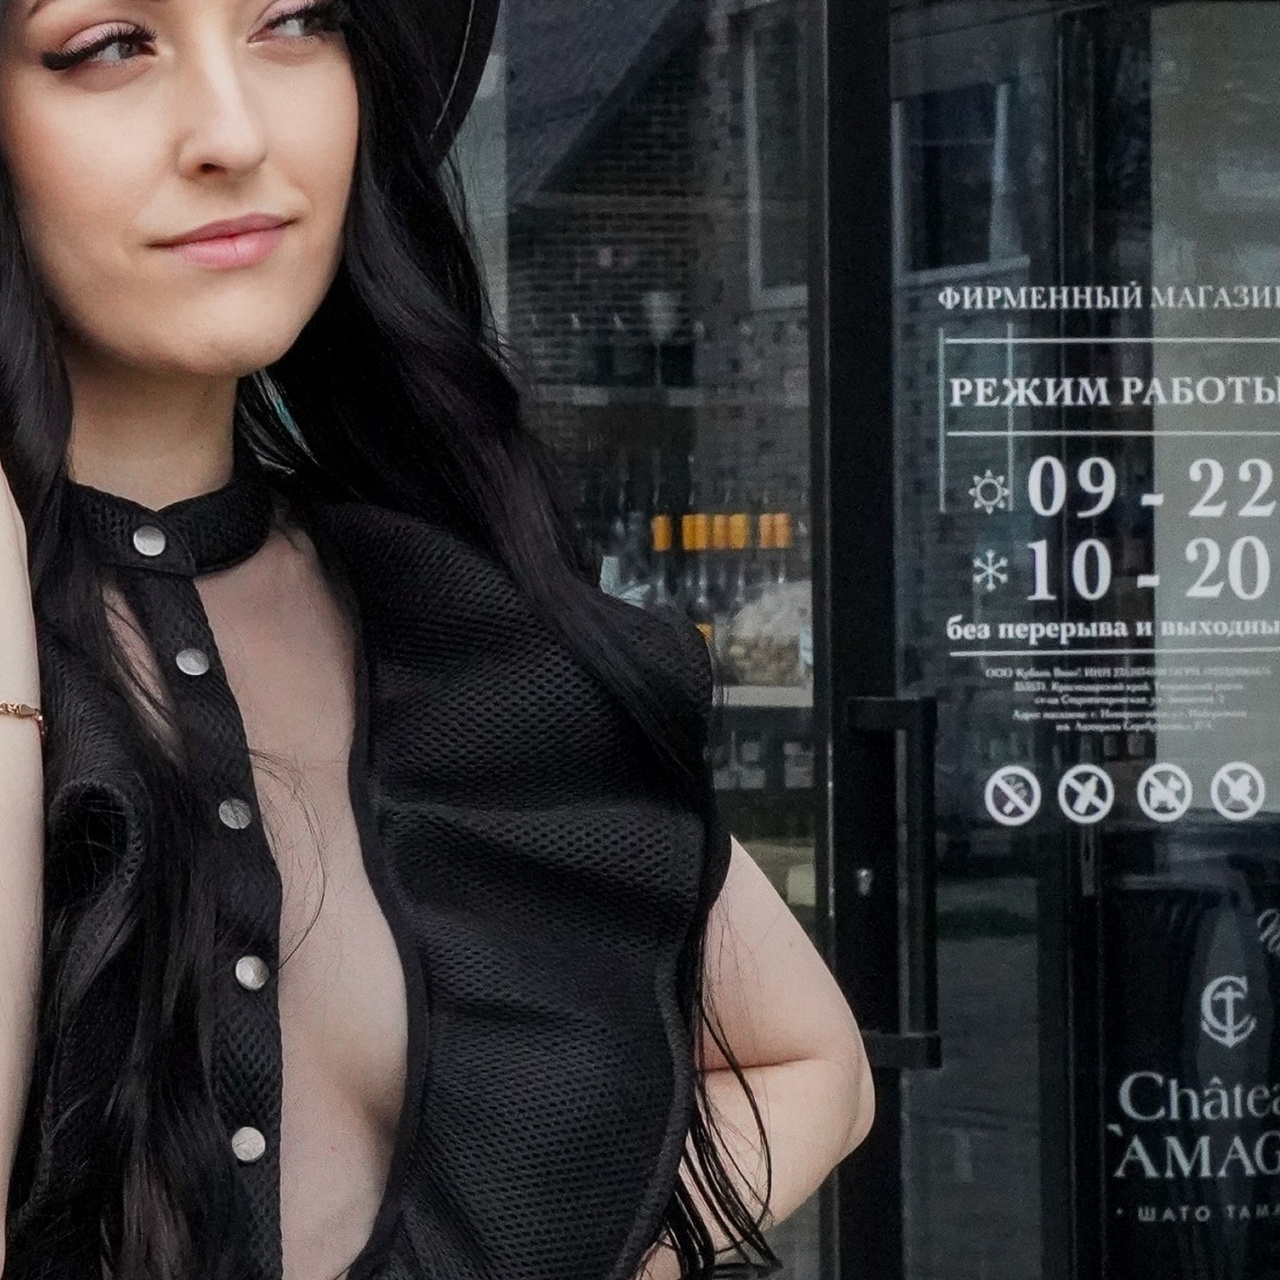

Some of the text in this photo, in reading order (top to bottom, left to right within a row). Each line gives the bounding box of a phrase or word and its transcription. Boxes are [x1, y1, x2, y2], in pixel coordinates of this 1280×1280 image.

[937, 280, 1143, 310] ФИРМЕННЫЙ
[949, 375, 1280, 407] РЕЖИМ РАБОТЫ
[1027, 455, 1117, 519] 09
[1187, 458, 1277, 518] 22
[1026, 538, 1112, 601] 10
[1184, 535, 1271, 600] 20
[946, 613, 991, 640] без
[998, 620, 1129, 646] перерыва
[1136, 620, 1153, 637] и
[1107, 1123, 1280, 1179] AMAG
[1137, 1205, 1211, 1222] ШАТО
